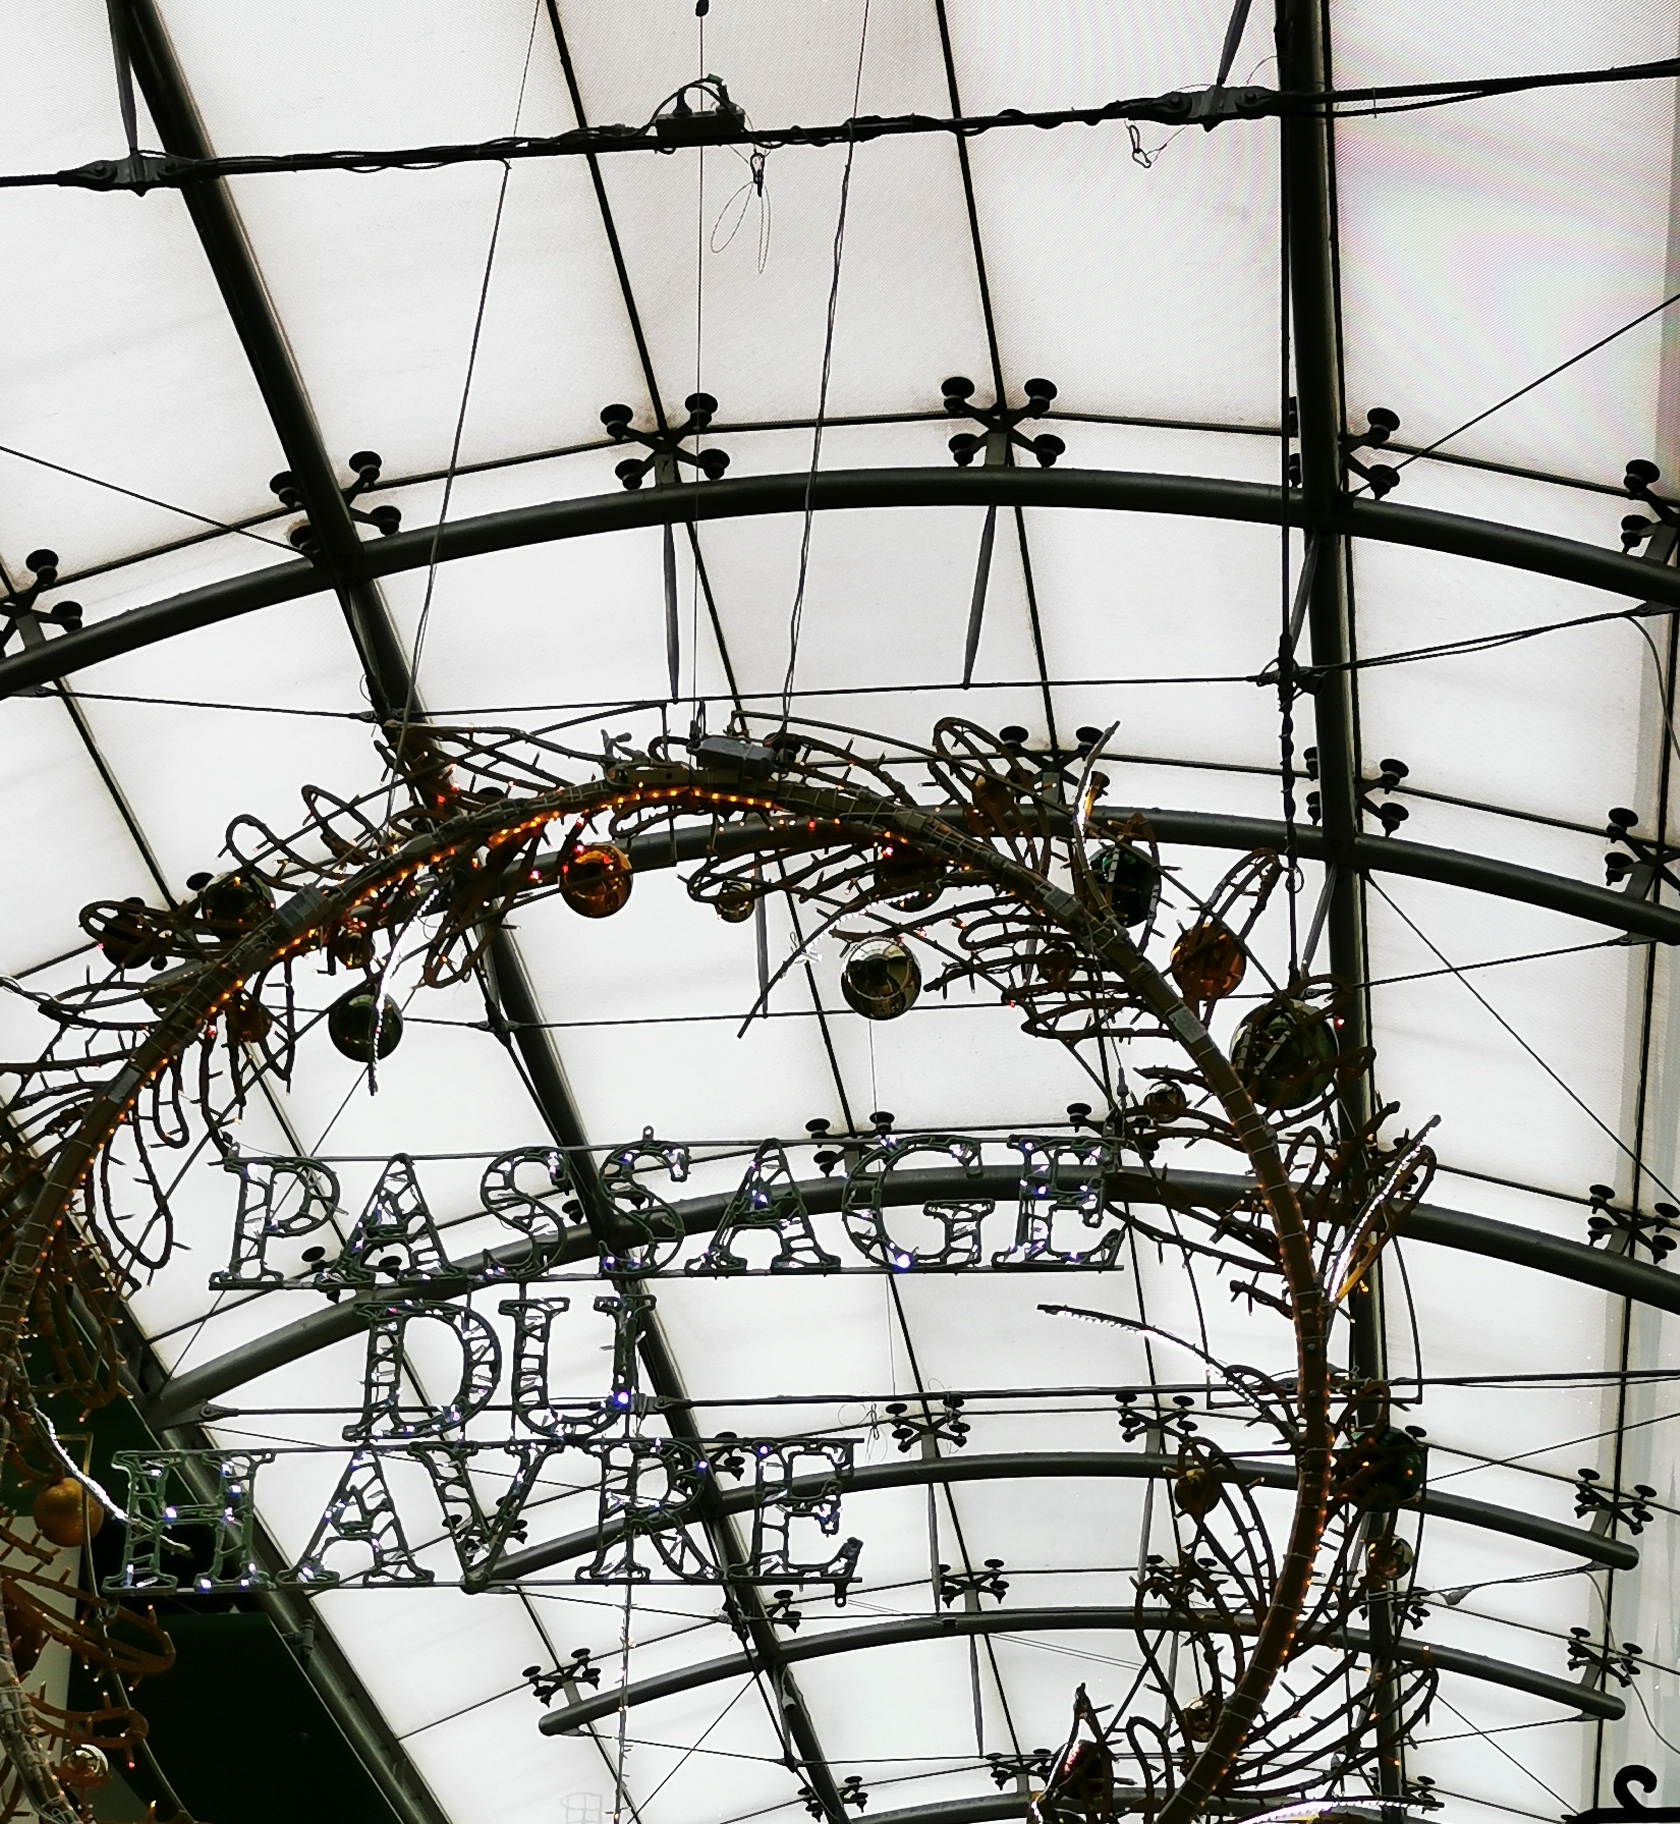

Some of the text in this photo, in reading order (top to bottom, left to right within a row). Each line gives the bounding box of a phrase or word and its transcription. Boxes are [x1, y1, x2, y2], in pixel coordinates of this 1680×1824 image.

[209, 1136, 1127, 1291] PASSAGE
[342, 1292, 657, 1442] DU
[103, 1437, 866, 1594] HAVRE
